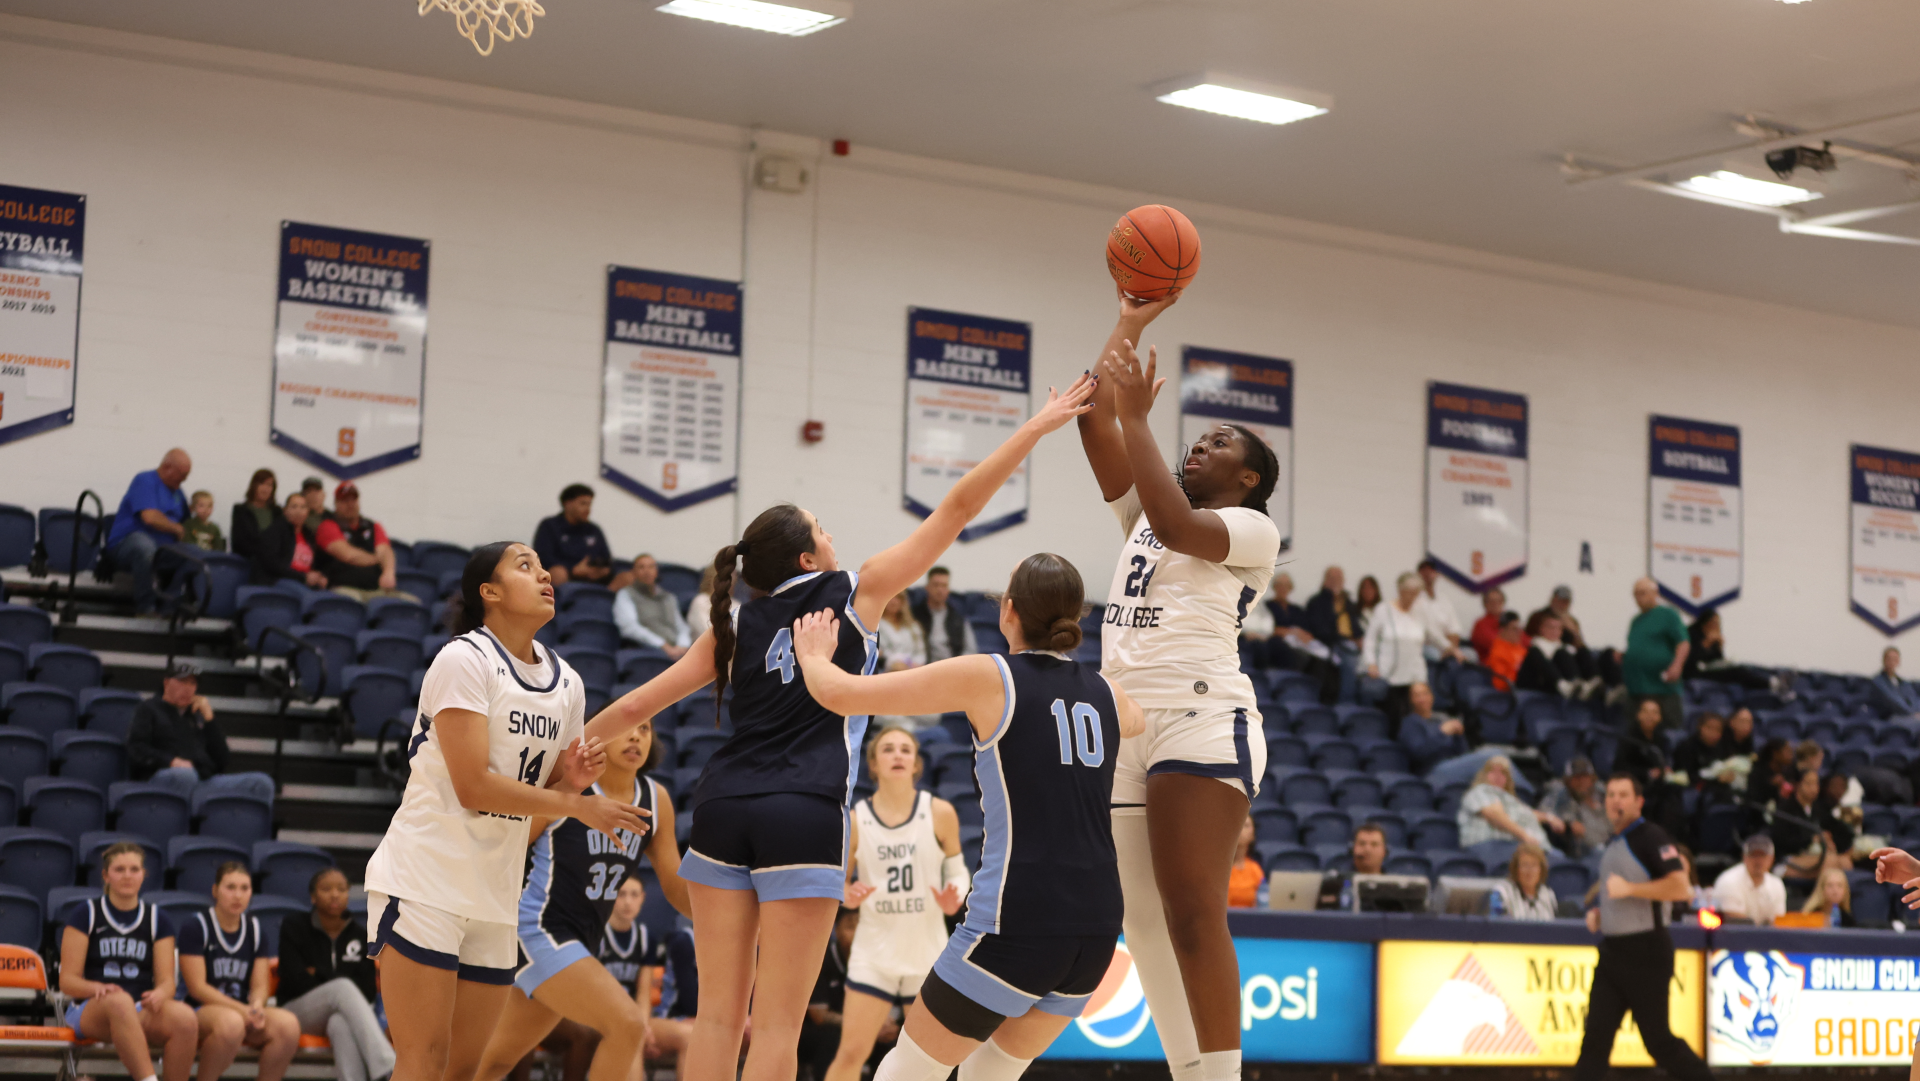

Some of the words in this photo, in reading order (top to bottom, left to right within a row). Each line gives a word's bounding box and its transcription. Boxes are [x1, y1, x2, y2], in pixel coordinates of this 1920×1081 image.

[289, 236, 341, 259] SNOW
[344, 243, 422, 270] COLLEGE
[0, 272, 41, 287] RENCE
[304, 259, 405, 289] WOMEN'S
[287, 278, 420, 312] BASKETBALL
[665, 286, 737, 312] COLLEGE
[646, 304, 706, 328] MEN'S
[614, 319, 735, 352] BASKETBALL
[914, 357, 1026, 389] BASKETBALL
[1133, 527, 1165, 551] SNO
[1578, 540, 1594, 576] A
[764, 626, 796, 685] 4
[508, 709, 561, 741] SNOW
[1050, 698, 1105, 768] 10
[517, 746, 547, 787] 14
[586, 826, 642, 861] OTERO
[585, 861, 626, 901] 32
[886, 863, 914, 895] 20
[874, 896, 926, 915] COLLEG
[98, 935, 148, 961] OTERO
[212, 956, 250, 981] OTERO
[1810, 957, 1876, 990] SNOW
[1879, 959, 1920, 991] COL
[1241, 966, 1319, 1031] psi
